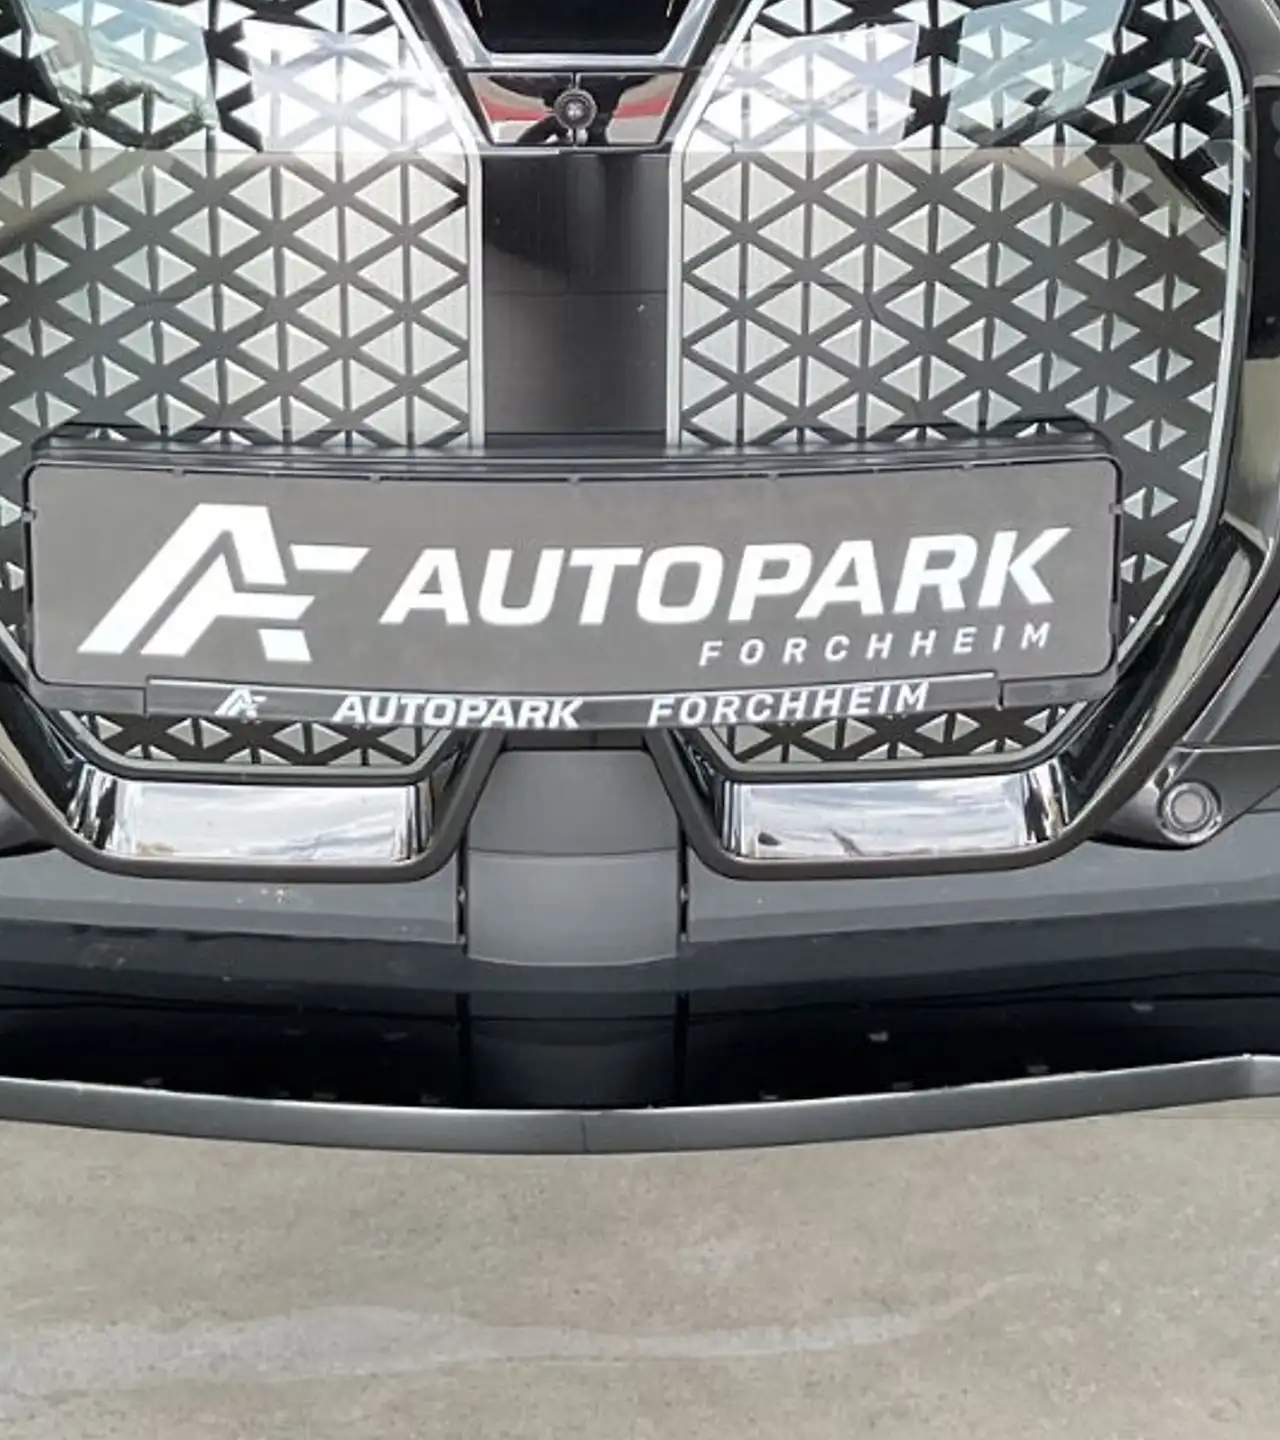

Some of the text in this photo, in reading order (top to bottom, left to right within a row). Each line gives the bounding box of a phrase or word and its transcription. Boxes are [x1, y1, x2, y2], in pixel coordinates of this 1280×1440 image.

[378, 526, 1072, 626] AUTOPARK
[699, 621, 1052, 667] FORCHHEIM
[332, 694, 584, 729] AUTOPARK
[648, 681, 930, 727] FORCHHEIM
